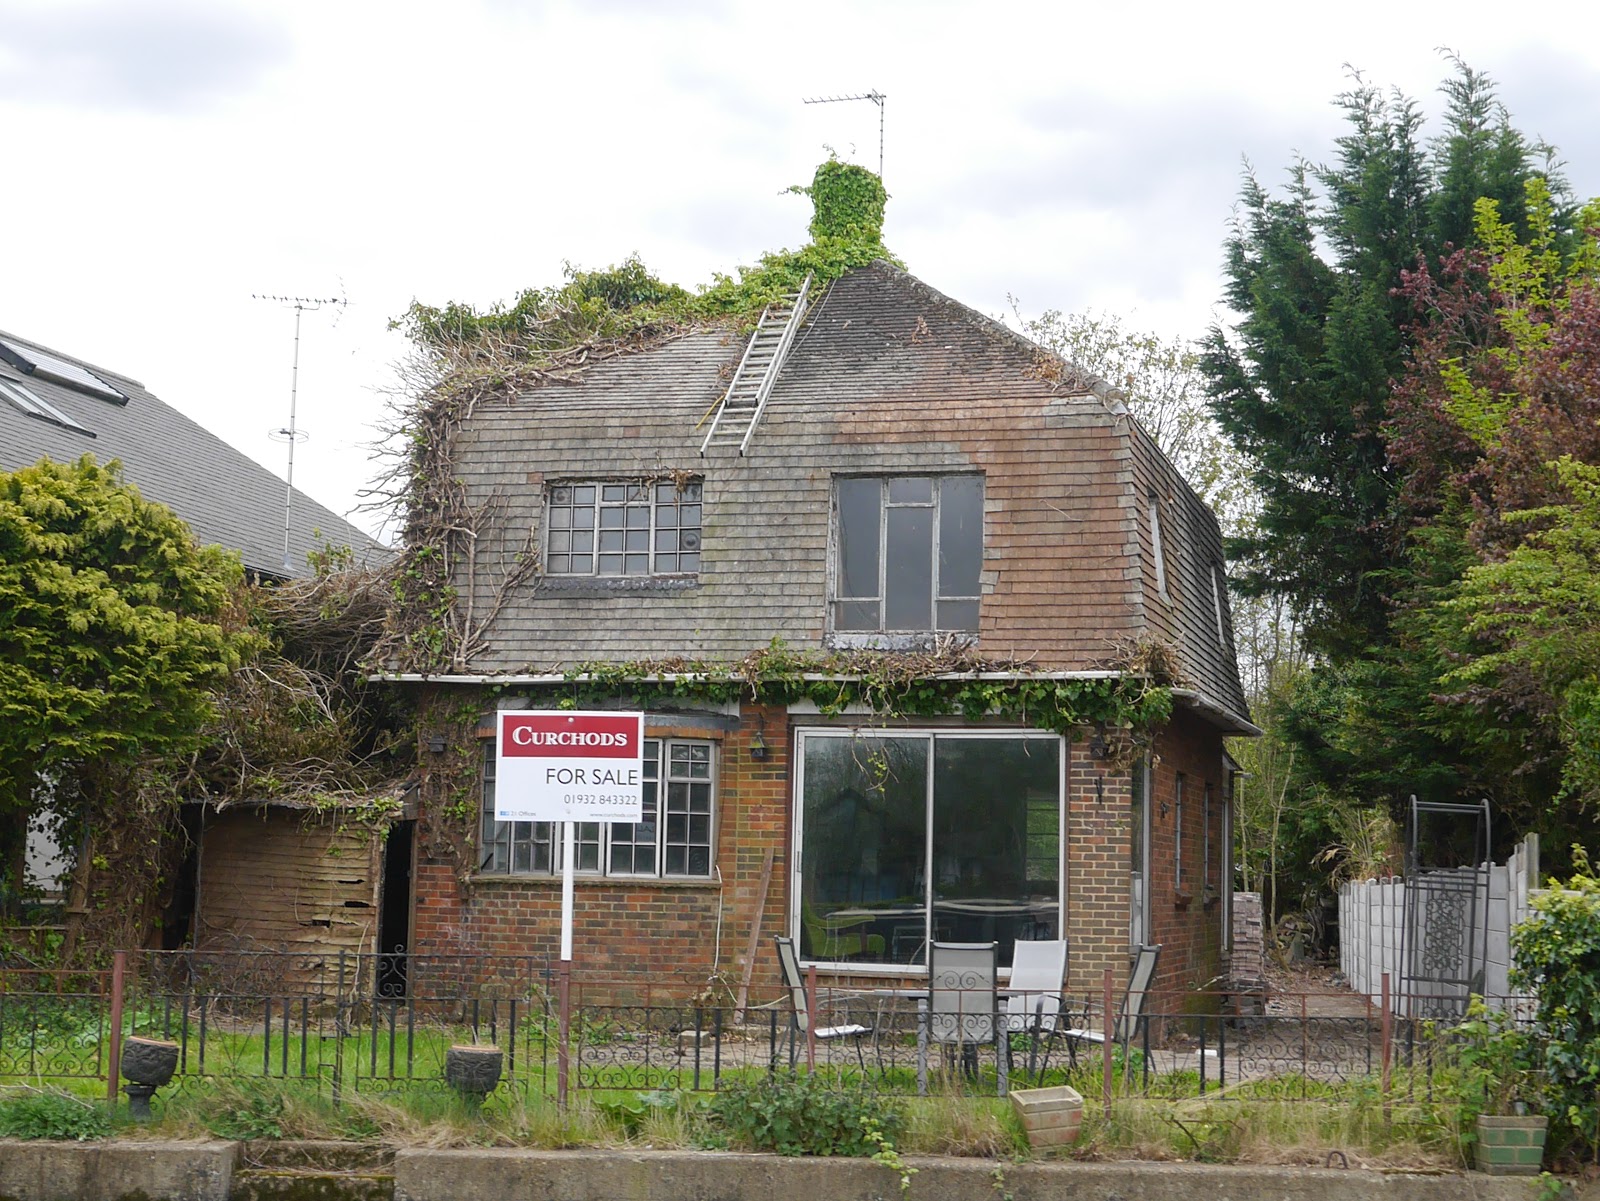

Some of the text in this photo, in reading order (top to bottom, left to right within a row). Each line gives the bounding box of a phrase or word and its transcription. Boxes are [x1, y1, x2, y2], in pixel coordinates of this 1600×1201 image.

[512, 726, 628, 747] CURCHODS
[546, 768, 638, 786] FOR SALE
[564, 794, 638, 805] 01932 843322
